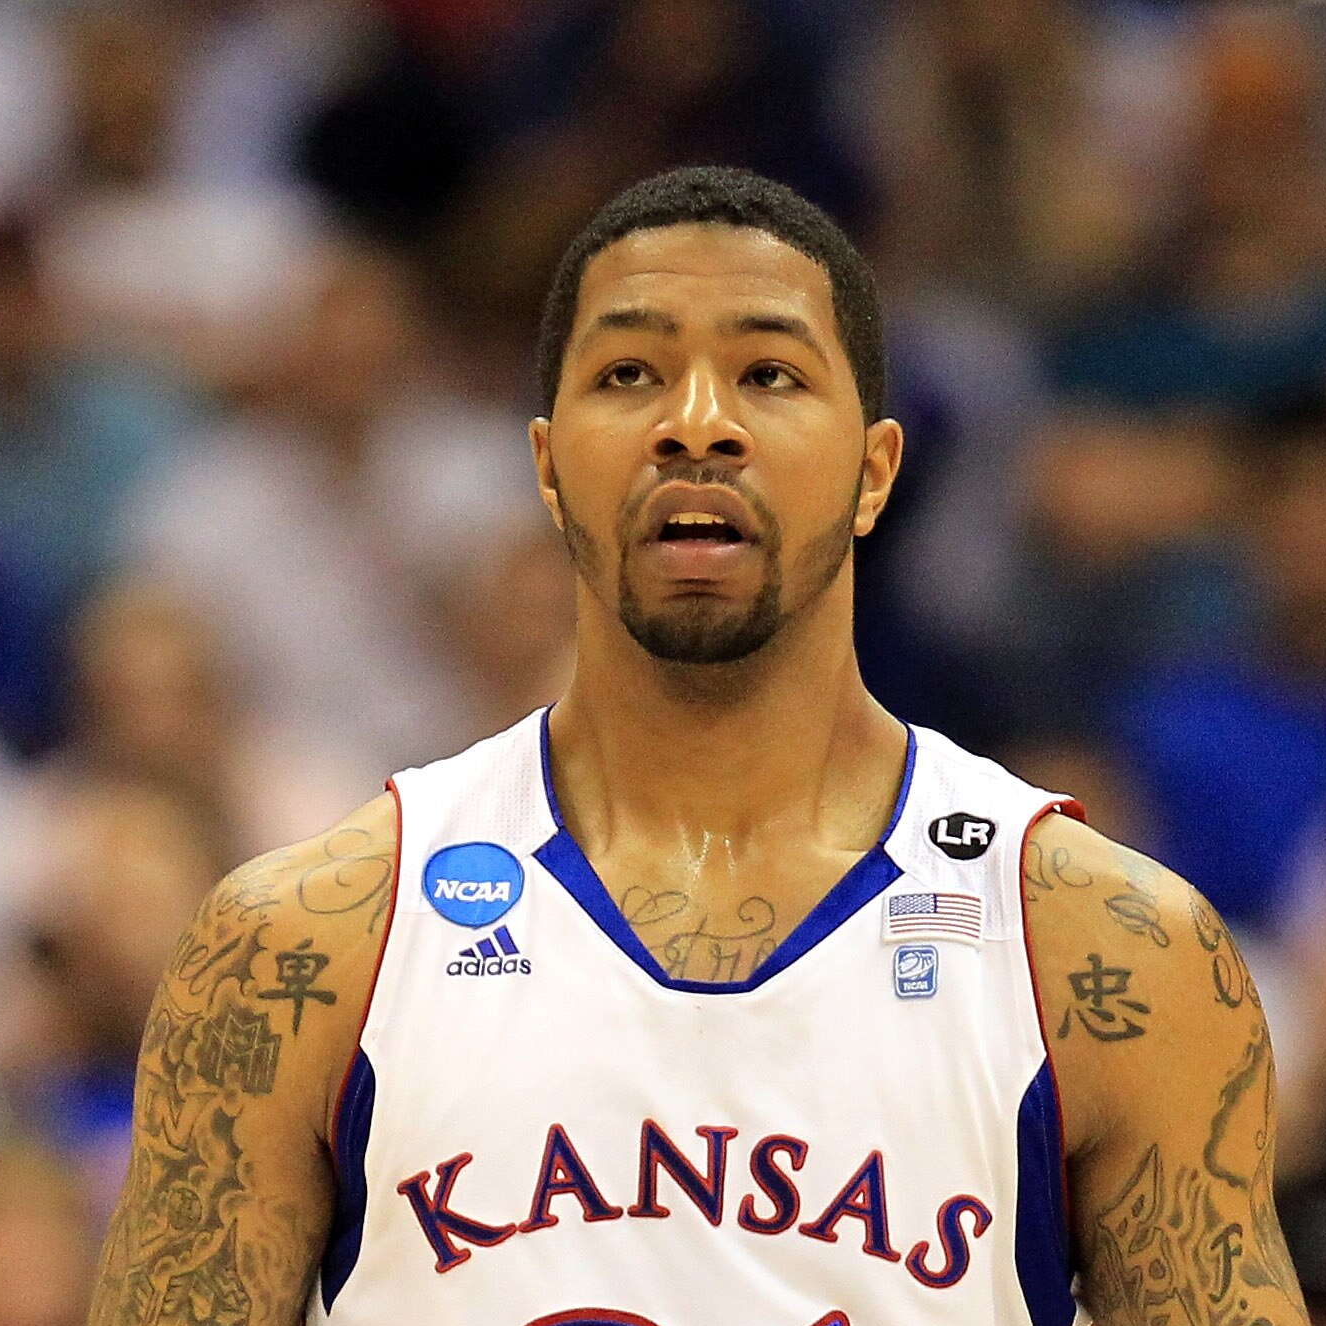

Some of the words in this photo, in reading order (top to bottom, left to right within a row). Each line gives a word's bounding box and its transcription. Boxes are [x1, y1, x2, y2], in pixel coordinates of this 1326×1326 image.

[936, 817, 989, 846] LR
[434, 877, 511, 902] NCAA
[446, 957, 532, 977] adidas
[1057, 953, 1151, 1042] 忠
[397, 1117, 993, 1289] KANSAS
